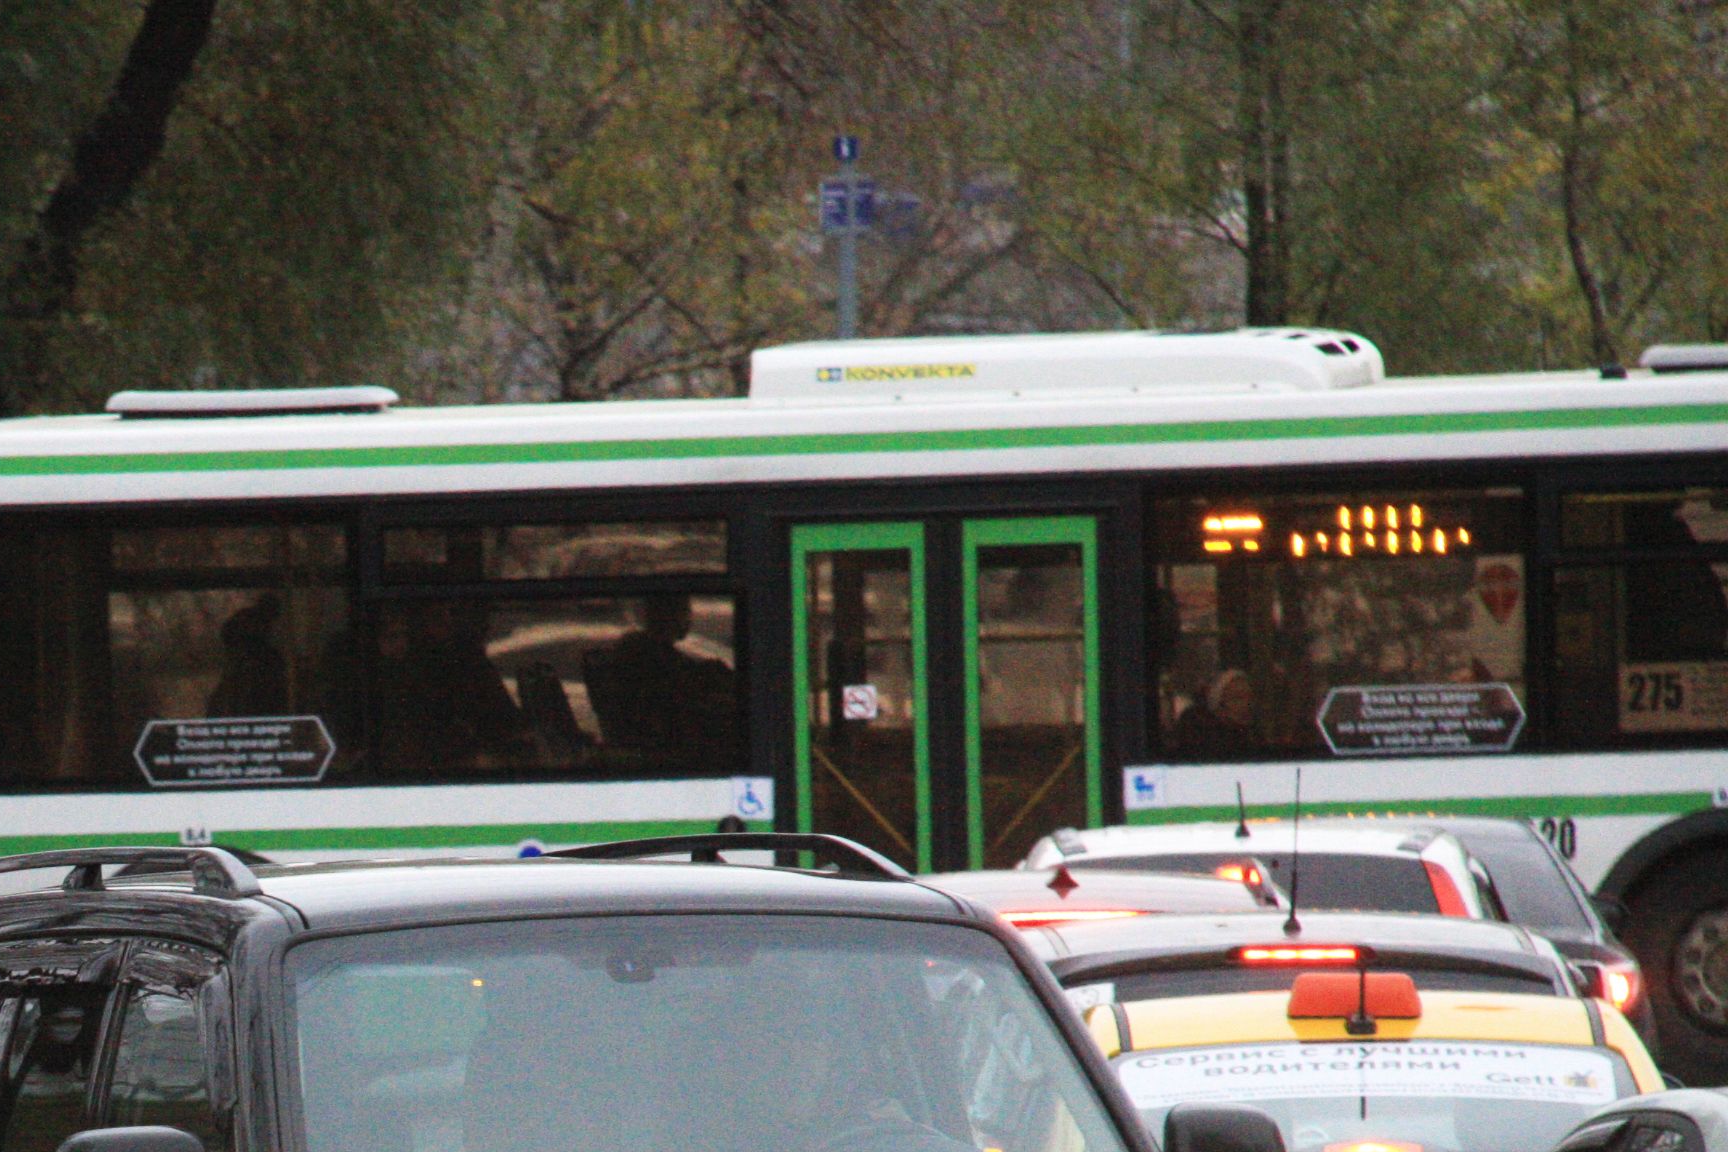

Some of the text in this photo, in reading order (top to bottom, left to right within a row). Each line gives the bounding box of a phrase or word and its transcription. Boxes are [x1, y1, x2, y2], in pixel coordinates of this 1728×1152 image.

[1628, 673, 1683, 711] 275
[1136, 1047, 1286, 1069] Сервис
[1336, 1045, 1527, 1059] лучшими
[1203, 1060, 1461, 1077] водителями
